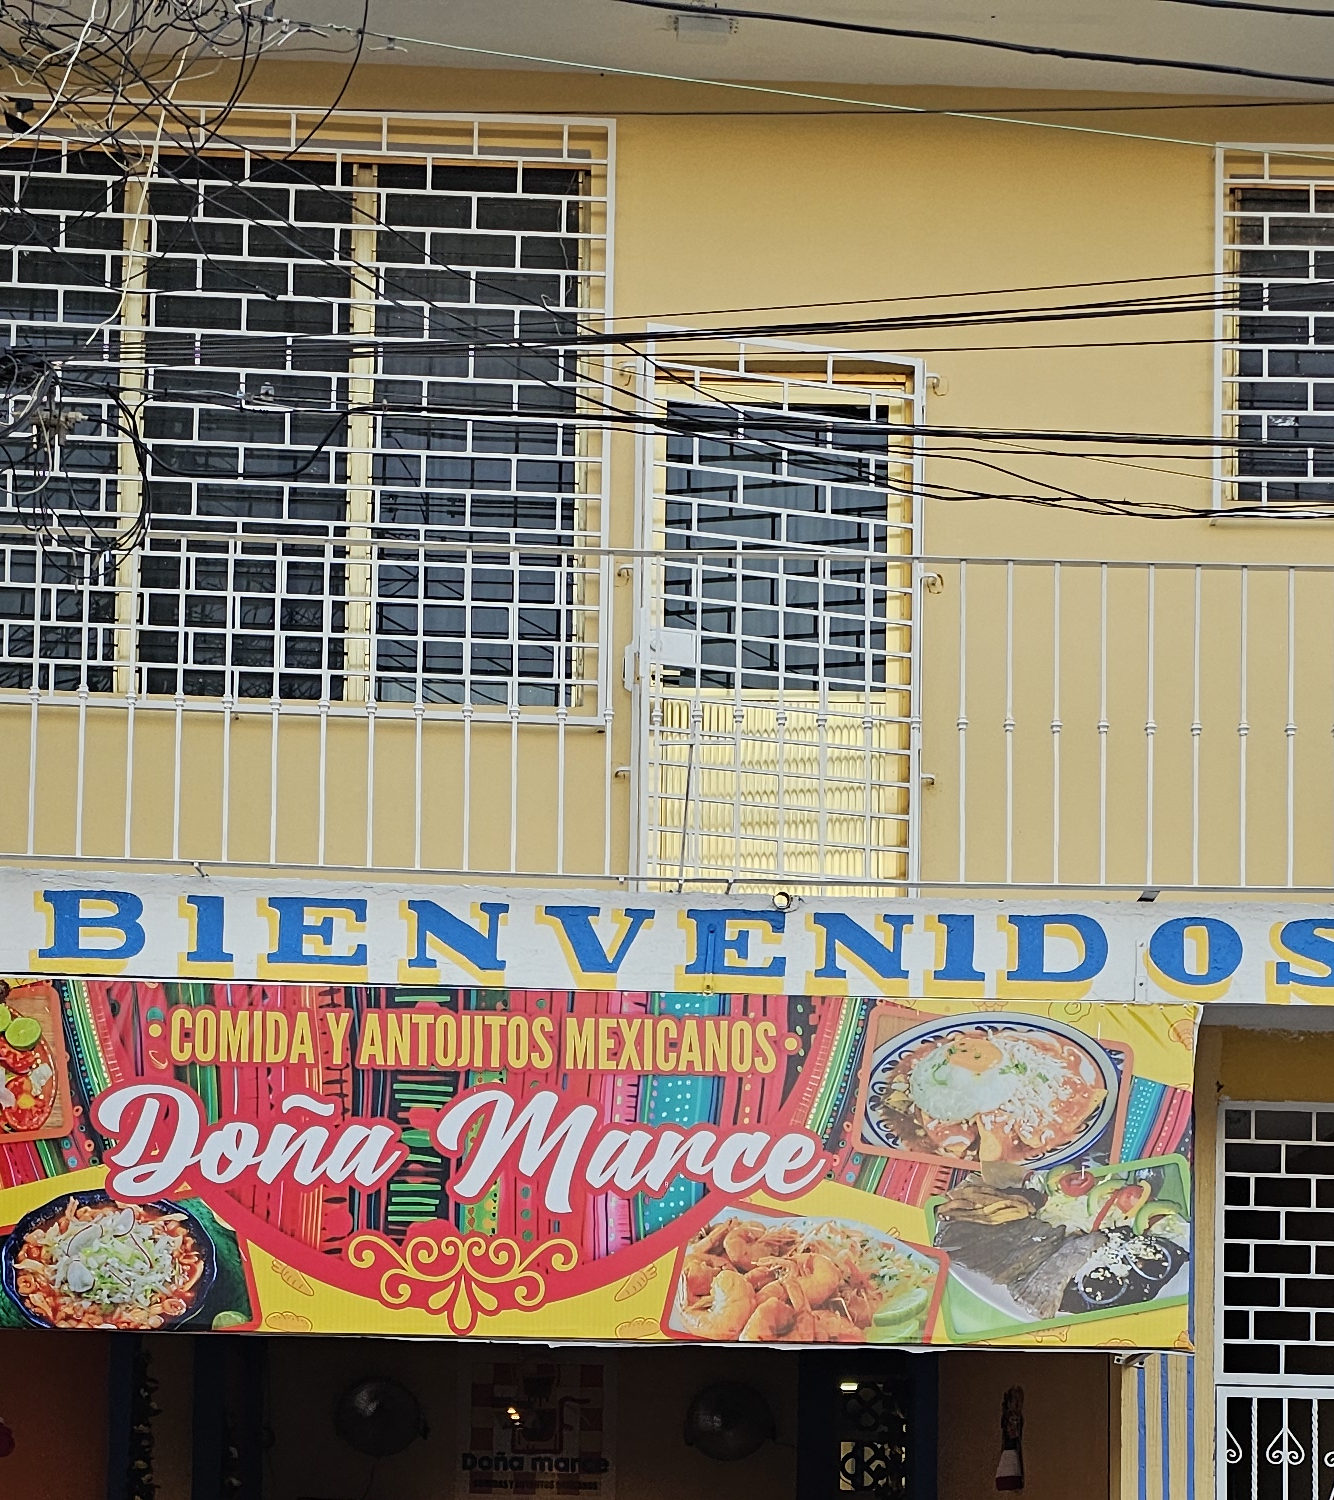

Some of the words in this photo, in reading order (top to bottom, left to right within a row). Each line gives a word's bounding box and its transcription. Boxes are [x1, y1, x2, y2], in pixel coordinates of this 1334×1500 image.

[170, 1008, 315, 1065] COMIDA
[325, 1012, 351, 1065] Y
[359, 1012, 554, 1070] ANTOJITOS
[565, 1016, 778, 1074] MEXICANOS
[98, 1083, 402, 1198] Doña
[436, 1090, 827, 1214] Marce
[462, 1451, 524, 1471] Doña
